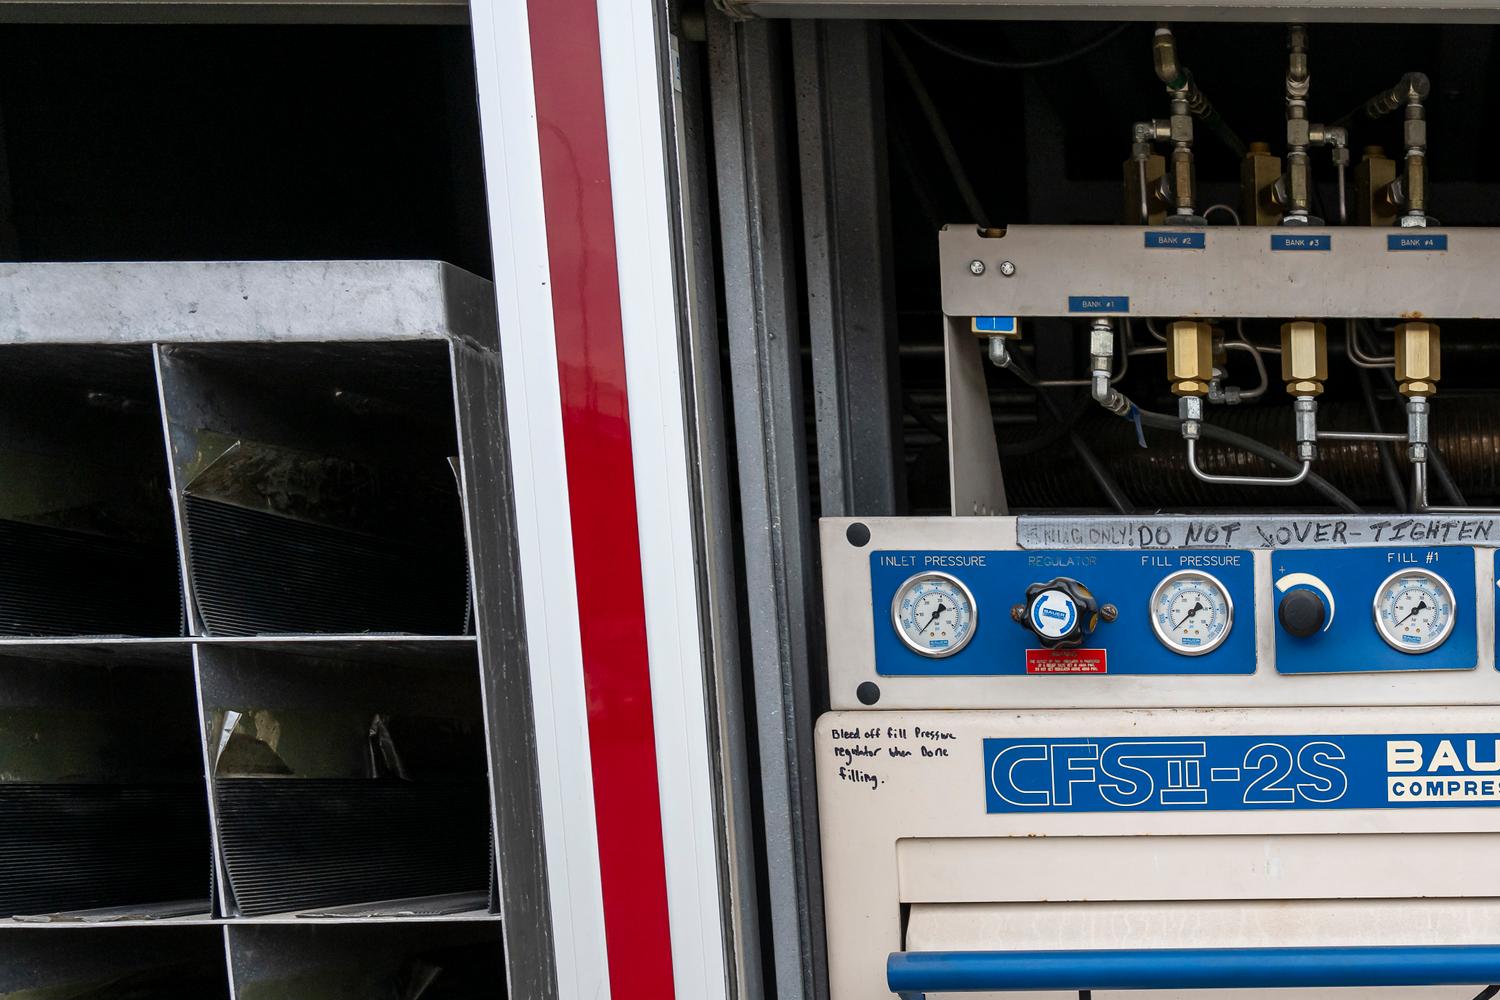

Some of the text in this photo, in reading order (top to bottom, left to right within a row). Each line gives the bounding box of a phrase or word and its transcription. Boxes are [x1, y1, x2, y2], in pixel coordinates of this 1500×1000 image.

[1158, 237, 1191, 245] BANK #2
[1285, 239, 1320, 247] BANK #3
[1401, 239, 1434, 247] BANK #4
[1082, 300, 1115, 308] BANK #1
[1138, 524, 1171, 546] DO
[1185, 522, 1241, 548] NOT
[880, 555, 986, 567] INLET PRESSURE
[1028, 556, 1097, 567] REGULATOR
[1141, 555, 1241, 567] FILL PRESSURE
[1387, 552, 1439, 564] FILL #1
[832, 728, 861, 739] Bleed
[864, 728, 881, 738] off
[887, 727, 907, 739] fill
